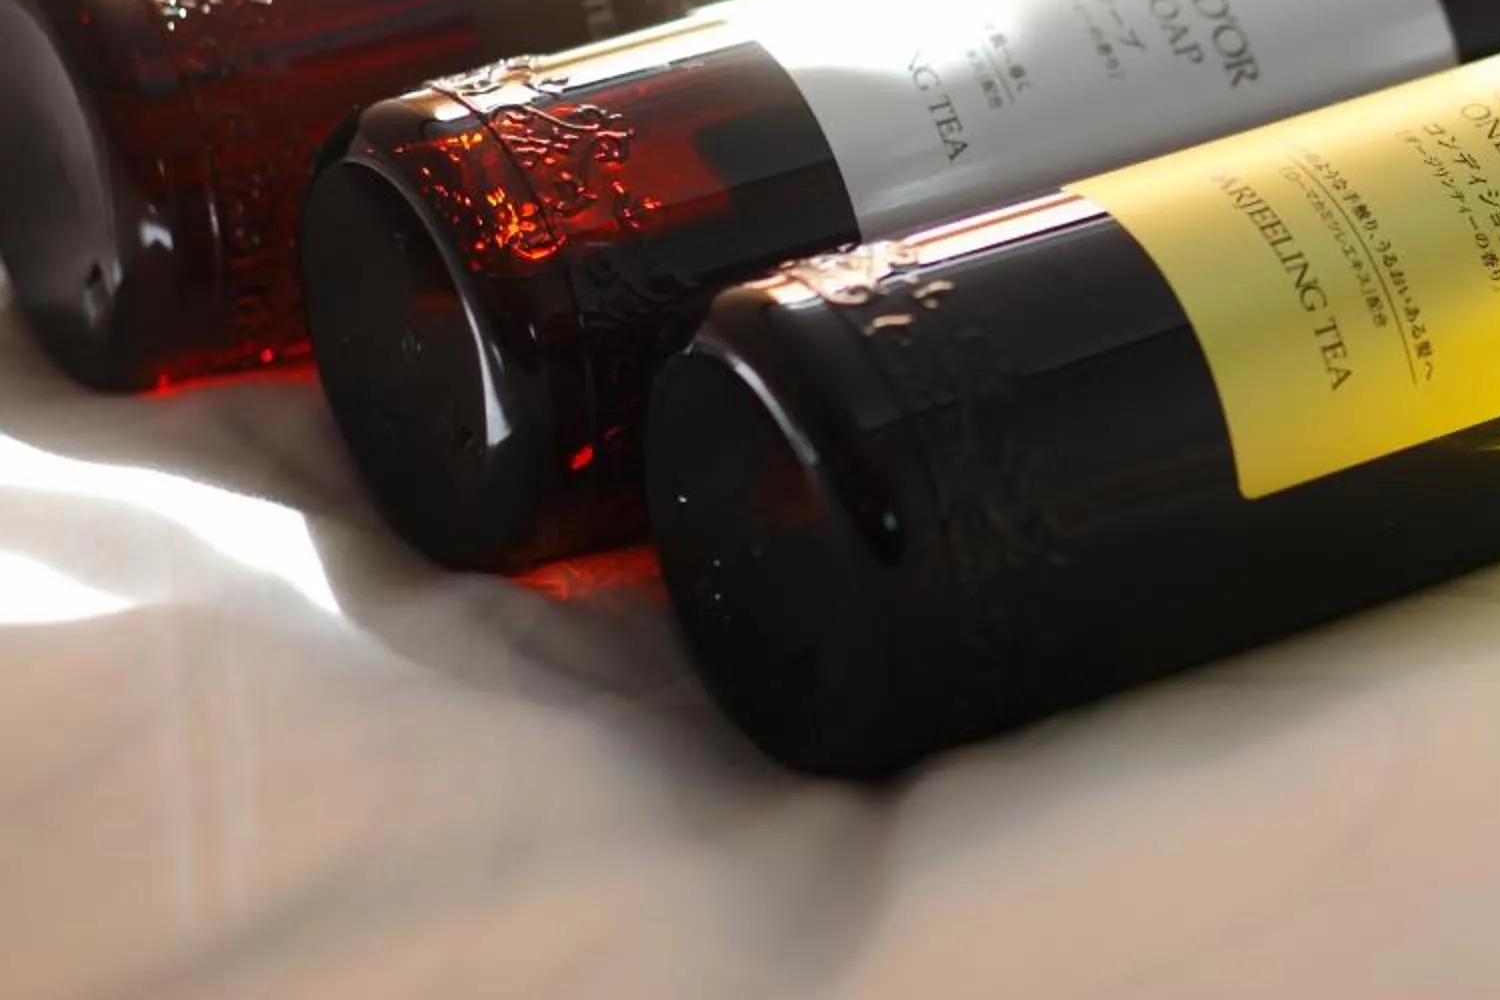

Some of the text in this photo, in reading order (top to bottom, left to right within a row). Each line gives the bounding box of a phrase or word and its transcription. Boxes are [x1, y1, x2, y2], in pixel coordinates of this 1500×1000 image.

[928, 93, 968, 161] TEA
[1214, 173, 1352, 392] ARJEELING TEA
